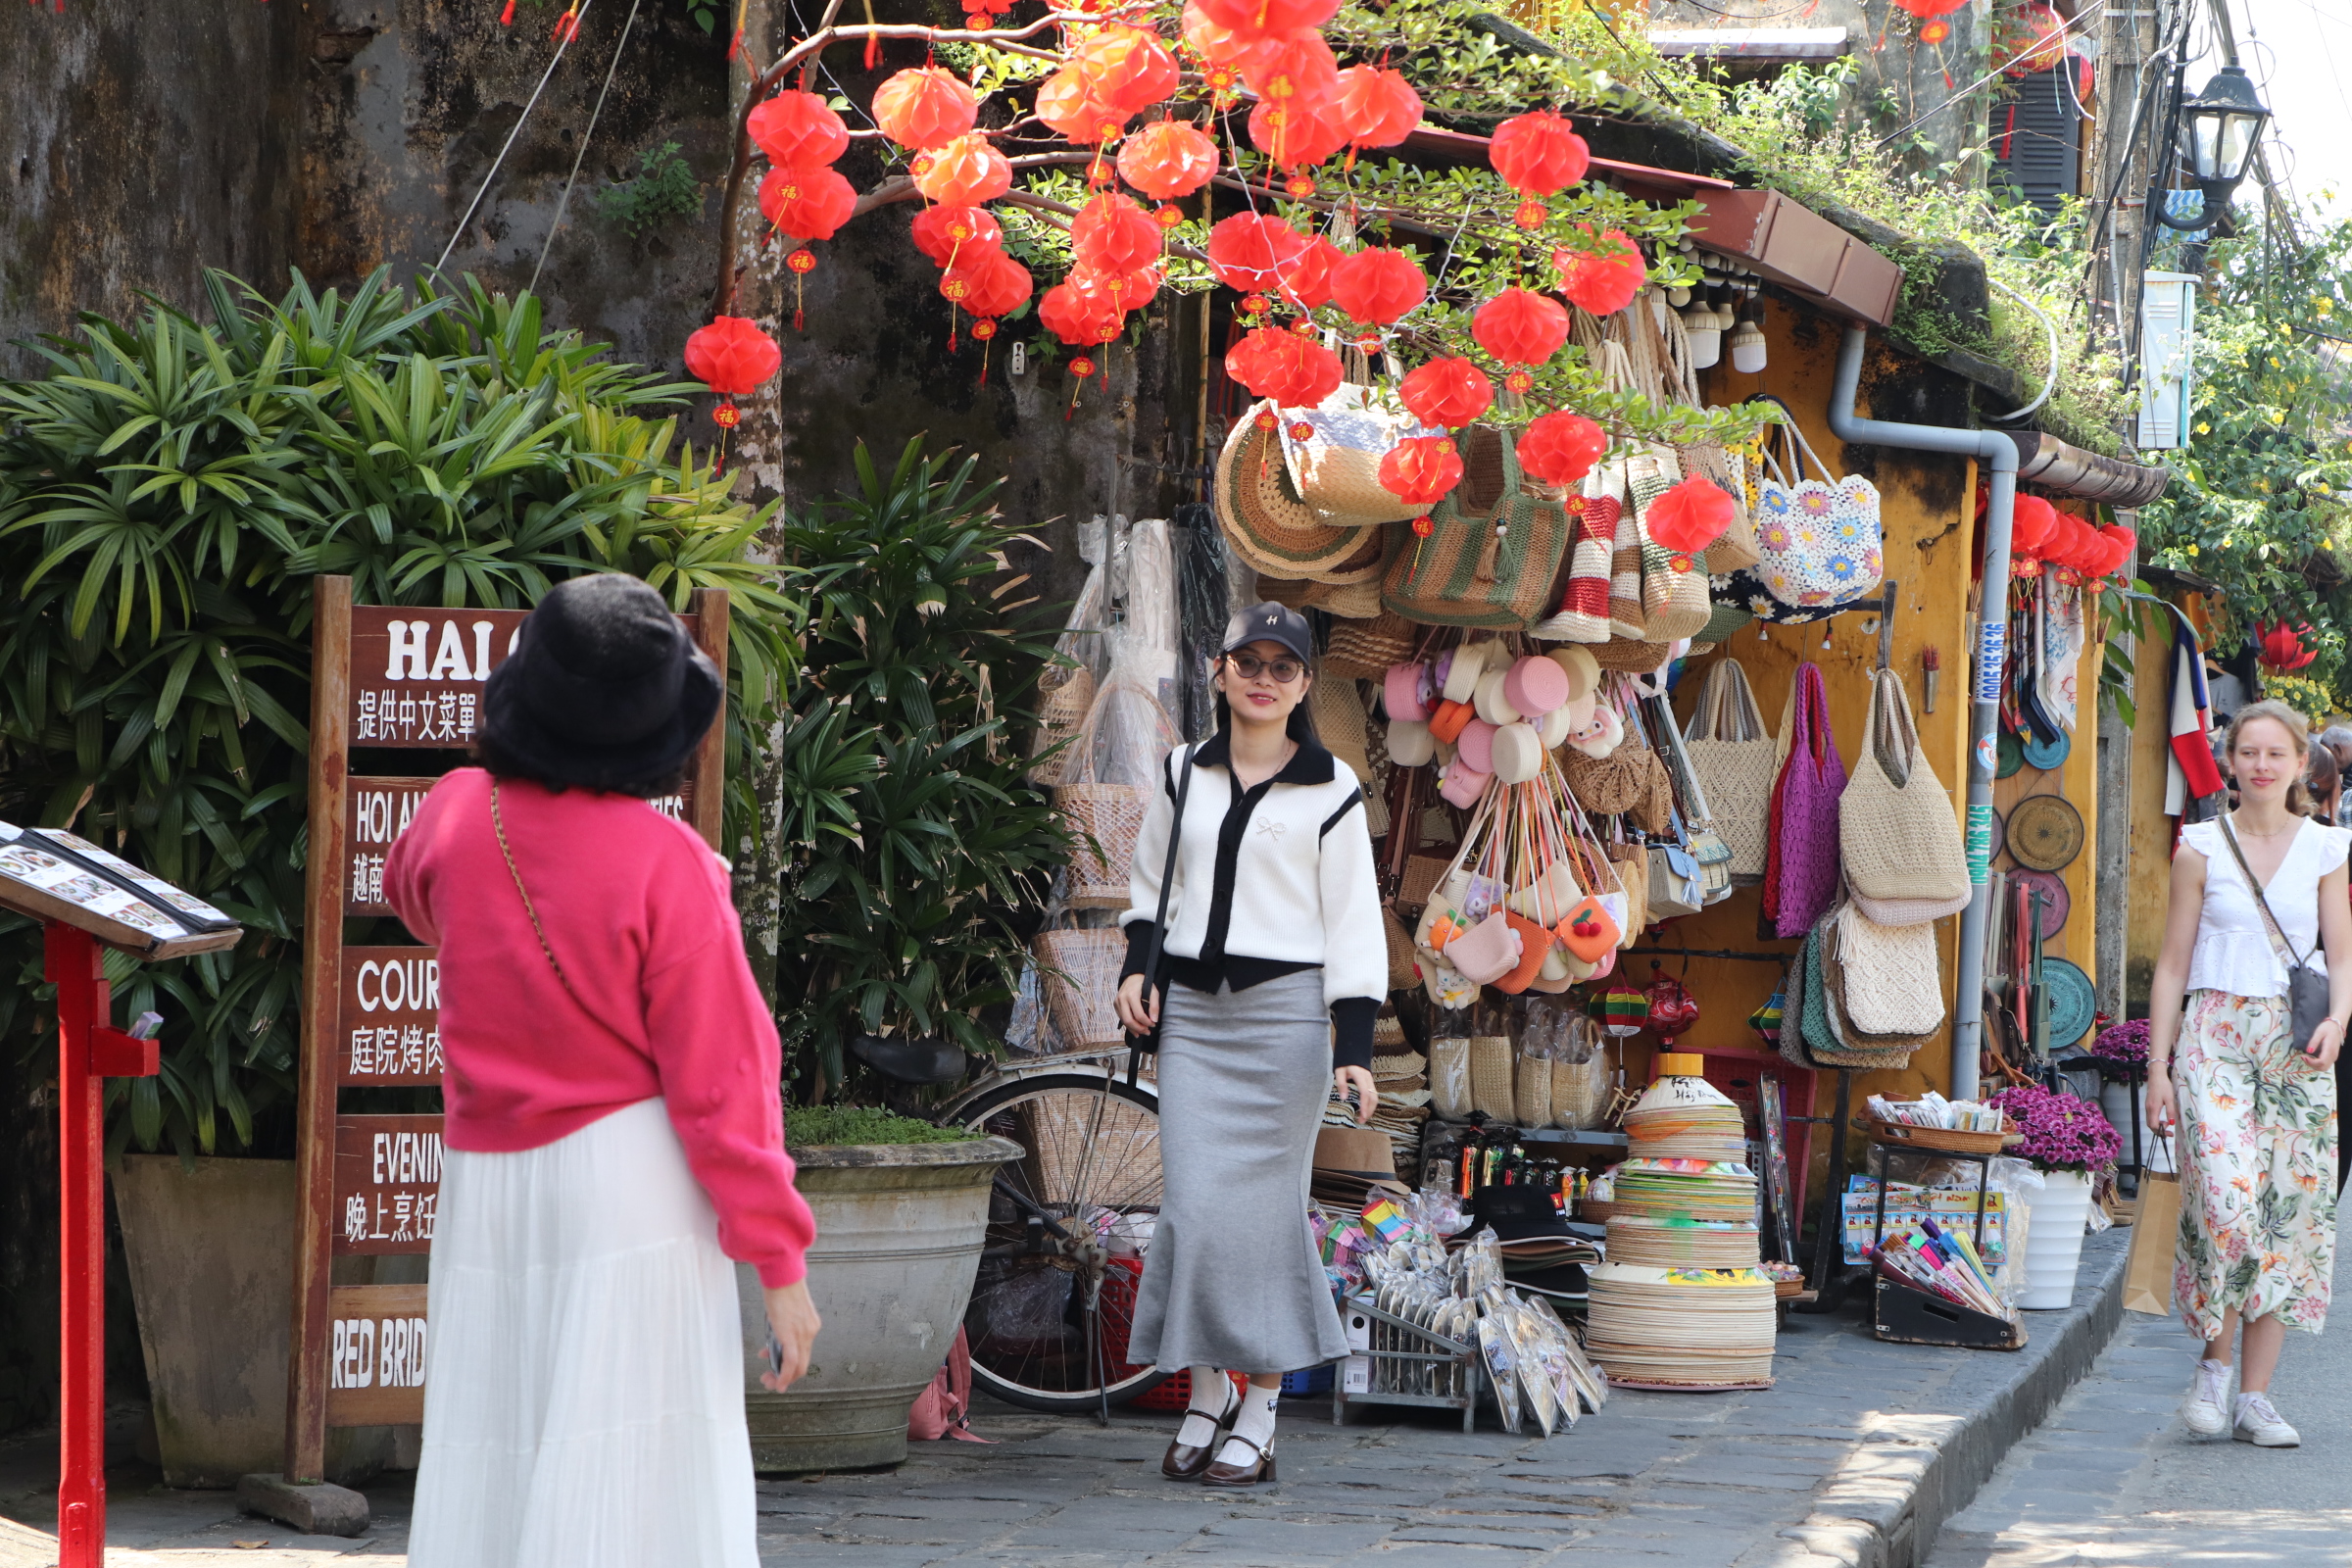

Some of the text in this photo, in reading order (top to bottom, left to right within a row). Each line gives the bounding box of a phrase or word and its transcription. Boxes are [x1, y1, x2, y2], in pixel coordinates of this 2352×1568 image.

[781, 184, 797, 199] 福
[794, 255, 808, 269] 福
[946, 280, 964, 297] 福
[1512, 373, 1528, 389] 福
[719, 410, 734, 423] 福
[1295, 425, 1309, 438] 福
[1569, 497, 1584, 513] 福
[1265, 614, 1278, 625] H
[385, 619, 493, 681] HAI
[358, 689, 476, 742] 提供中文菜單
[356, 791, 393, 843] HOI
[352, 853, 389, 904] 越南
[357, 958, 440, 1012] COUR
[349, 1024, 445, 1075] 庭院烤肉
[345, 1190, 437, 1243] 晚上烹饪
[331, 1317, 427, 1389] RED BRID
